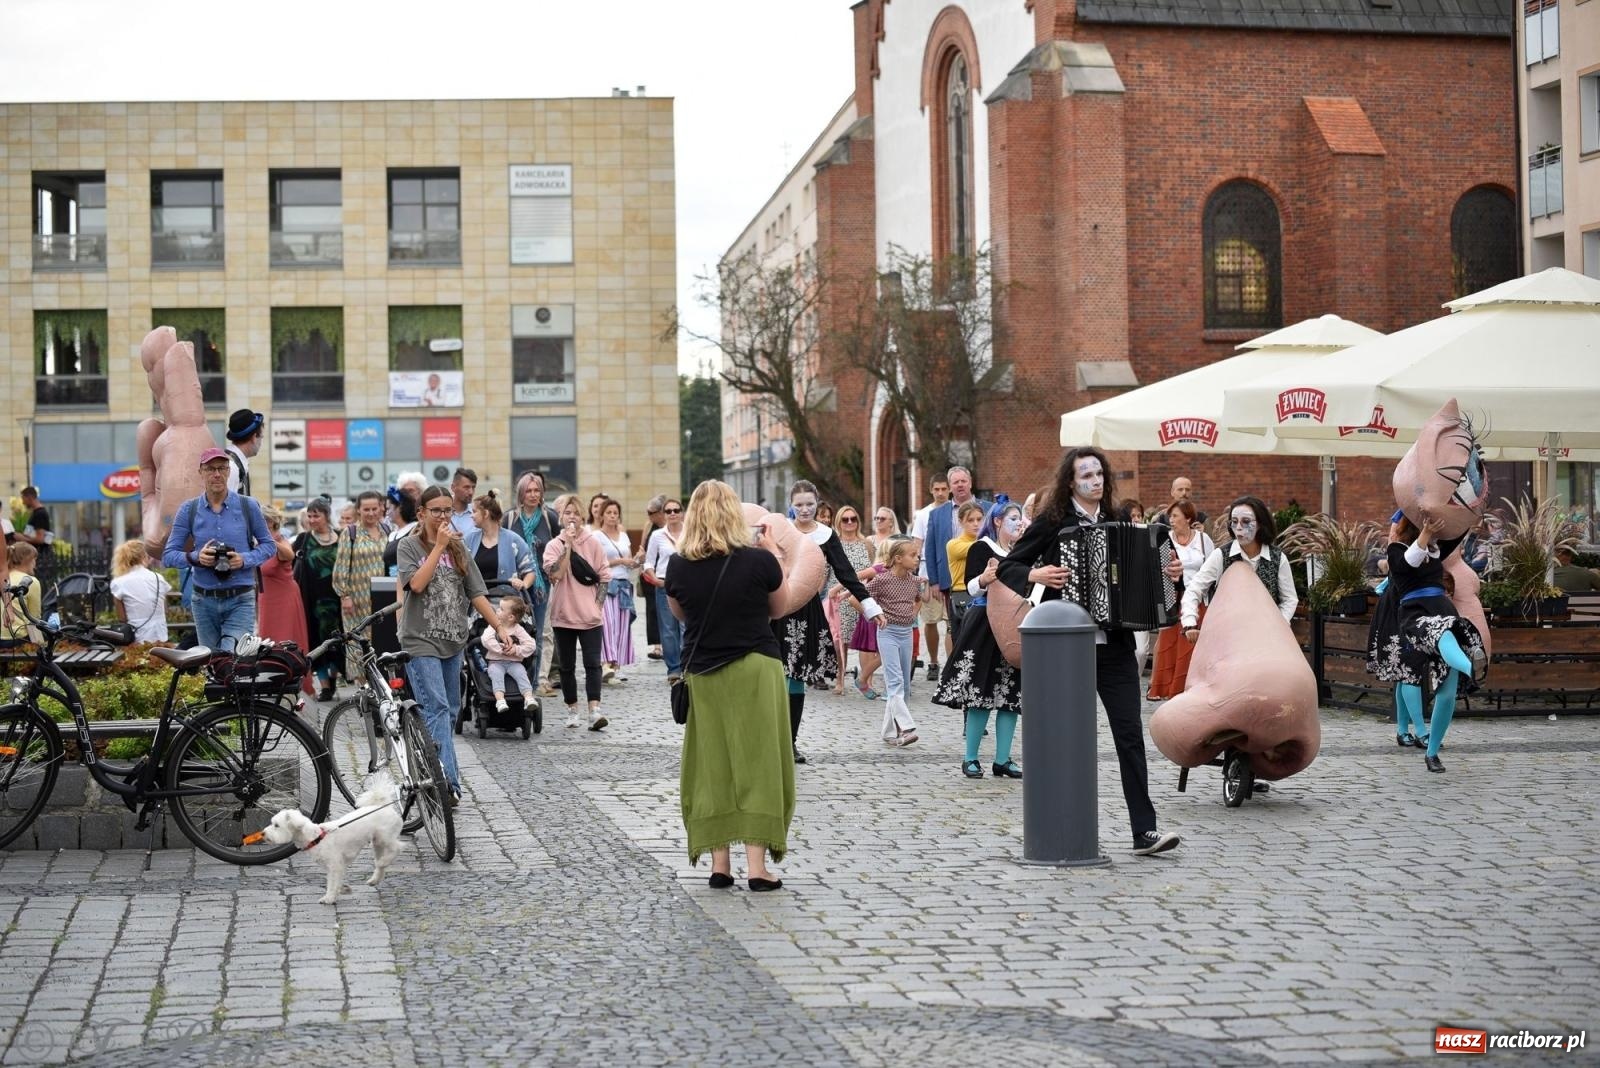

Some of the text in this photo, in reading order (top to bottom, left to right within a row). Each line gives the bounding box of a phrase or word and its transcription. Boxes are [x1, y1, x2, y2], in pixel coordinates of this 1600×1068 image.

[1282, 391, 1321, 412] ŻYWIEC
[1165, 420, 1212, 438] ŻYWIEC
[109, 475, 140, 488] PEPC
